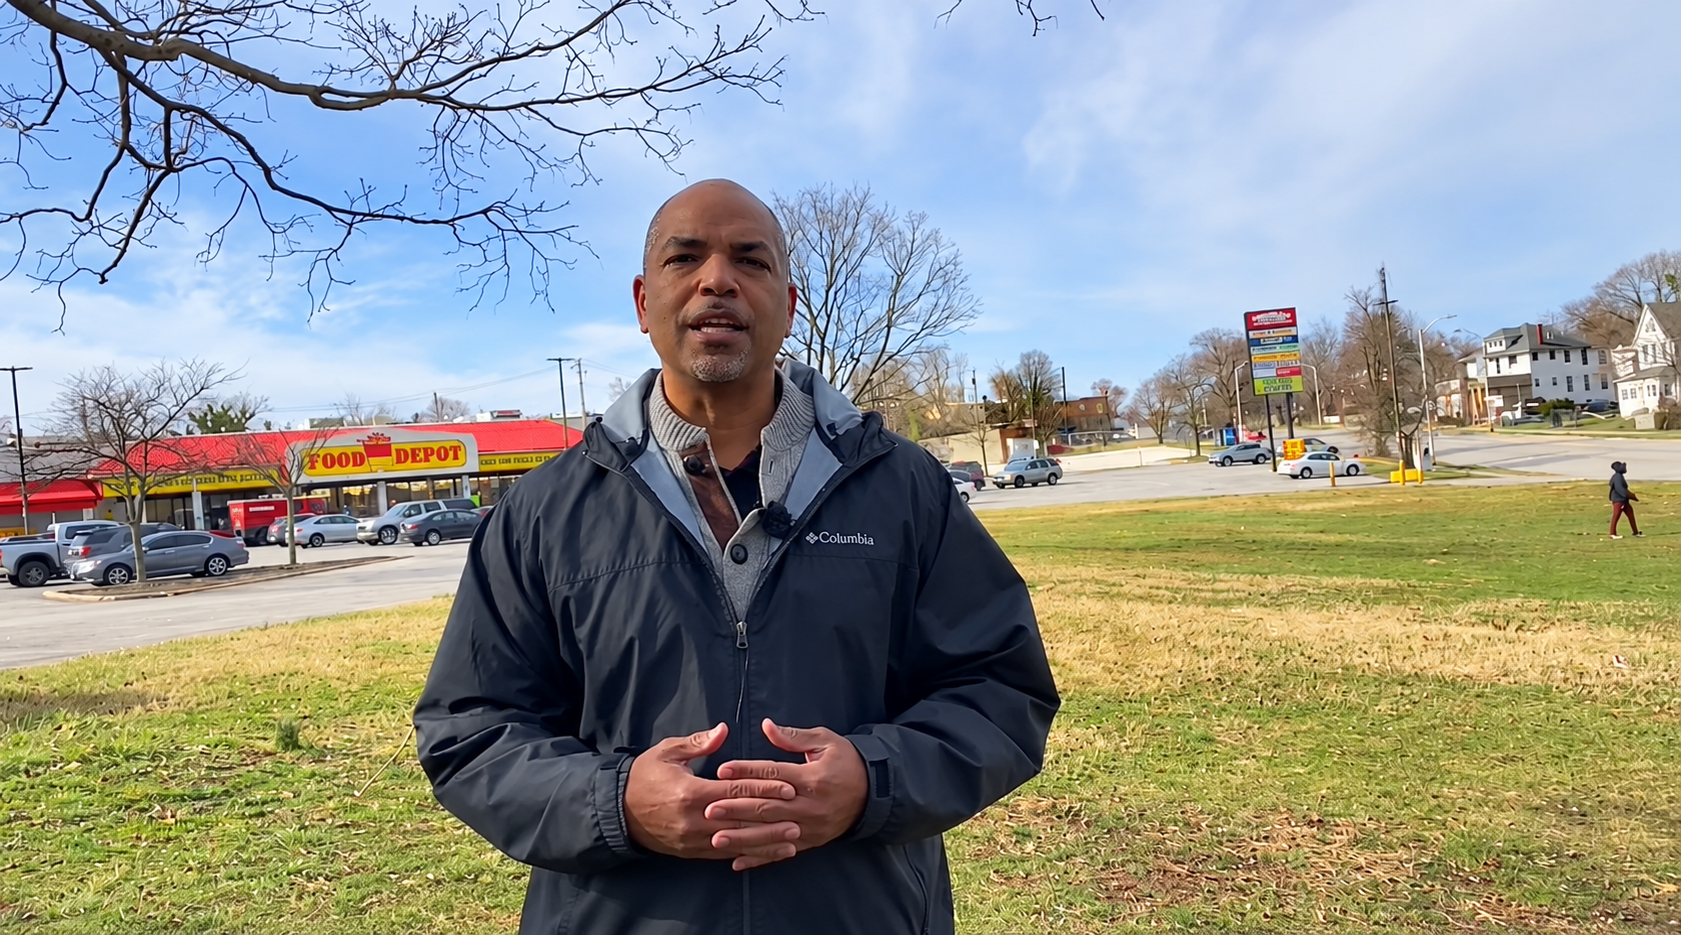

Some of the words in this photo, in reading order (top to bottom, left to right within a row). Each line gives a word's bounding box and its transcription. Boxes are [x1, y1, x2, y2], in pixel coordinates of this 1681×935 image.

[308, 451, 366, 470] FOOD
[395, 445, 462, 465] DEPOT
[819, 531, 874, 545] Columbia
